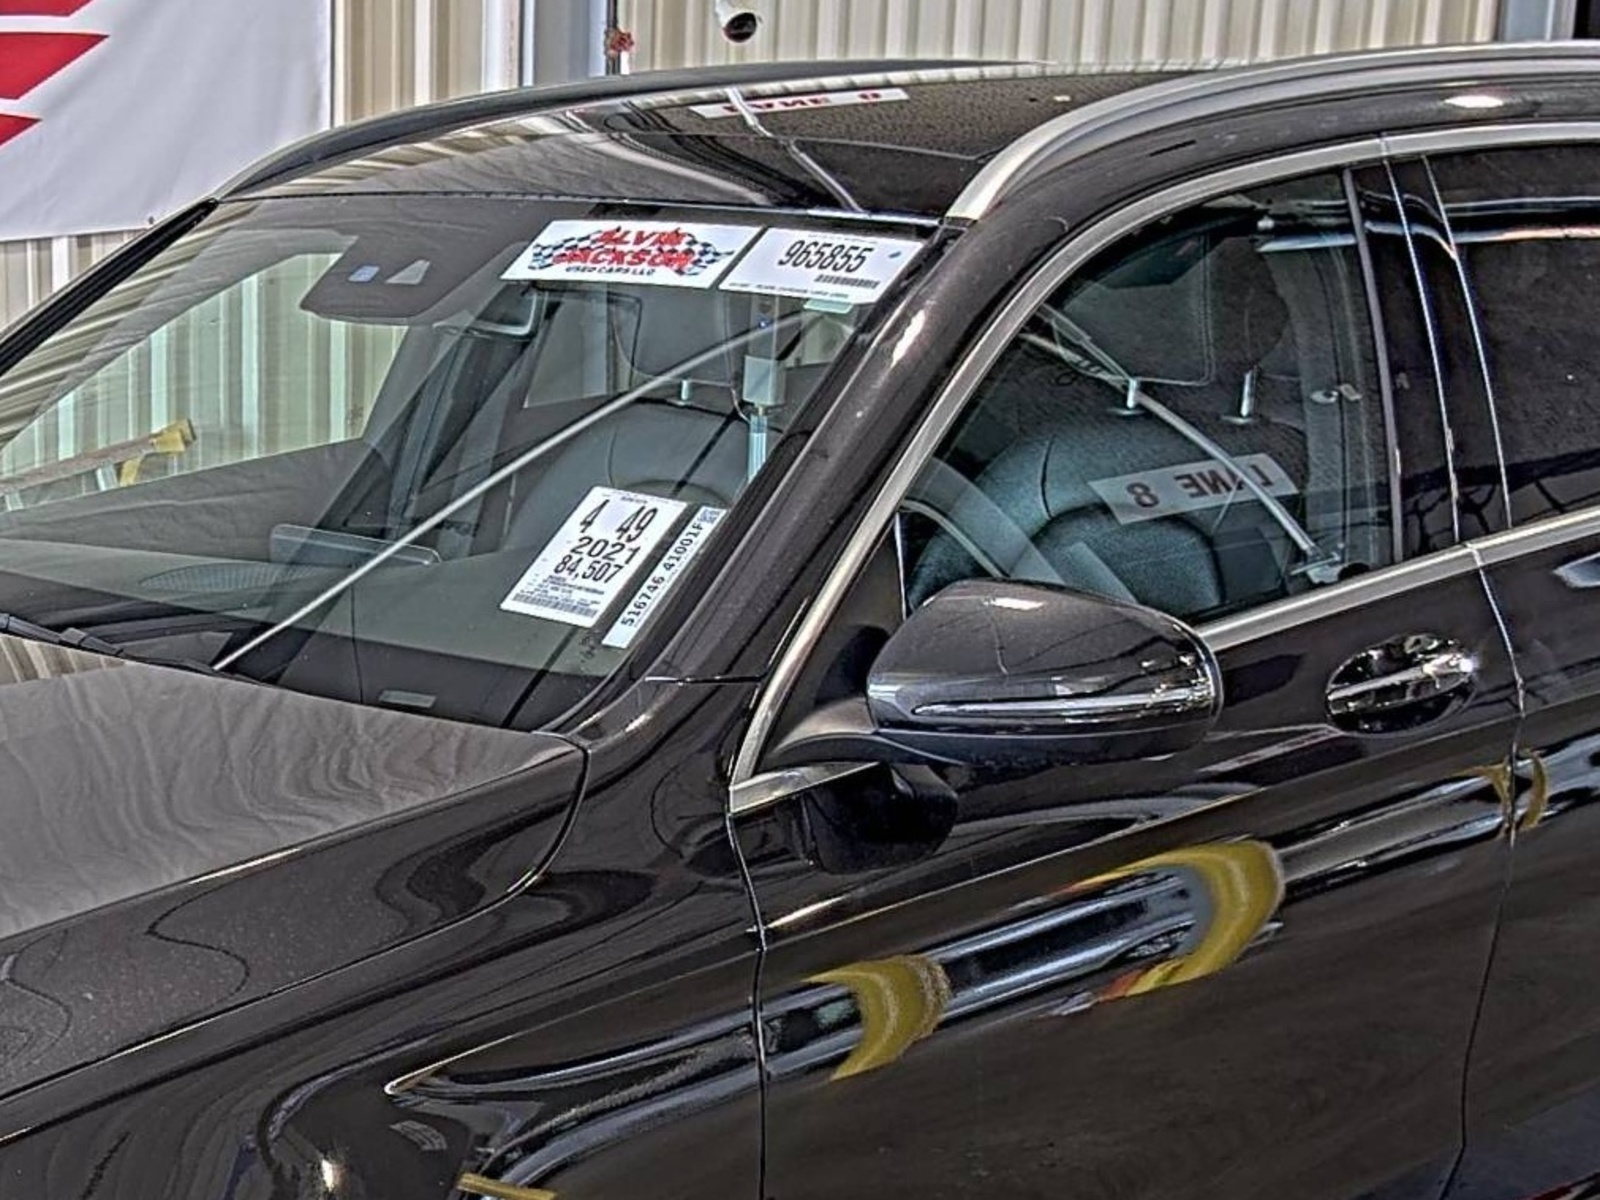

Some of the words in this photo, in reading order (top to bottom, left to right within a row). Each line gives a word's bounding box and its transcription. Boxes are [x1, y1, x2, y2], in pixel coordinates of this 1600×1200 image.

[594, 225, 688, 249] ALVIN
[551, 247, 699, 272] JACKSON
[777, 239, 874, 273] 965855
[579, 499, 610, 534] 4
[616, 505, 659, 543] 49
[570, 535, 642, 565] 2021
[553, 555, 624, 584] 84,507
[620, 575, 666, 627] 516746
[663, 521, 705, 574] 41001F
